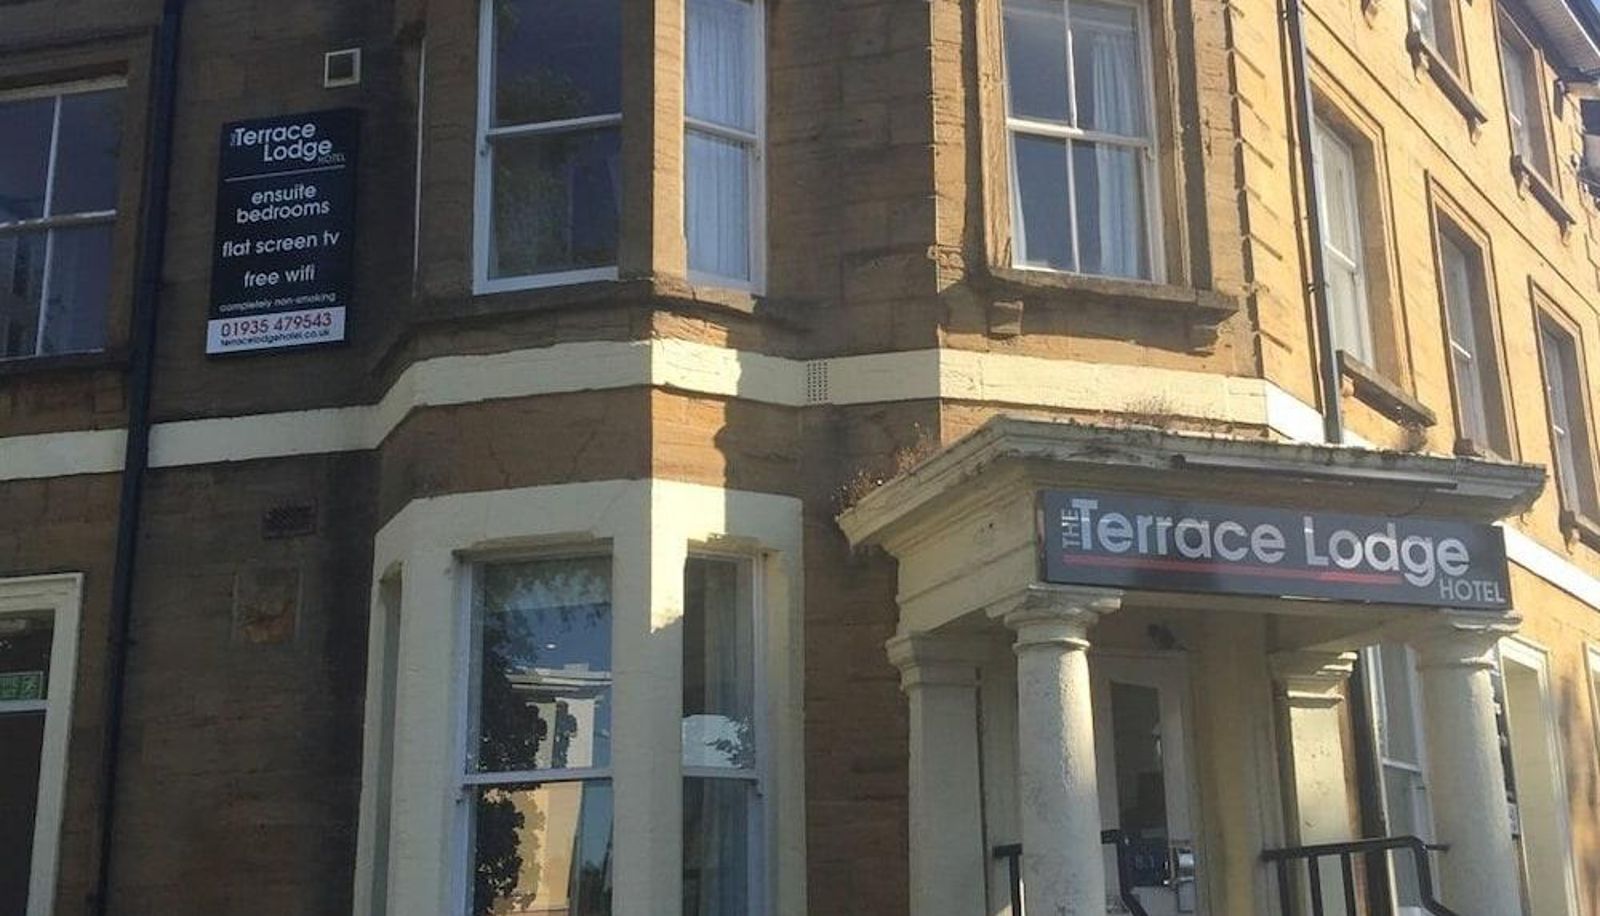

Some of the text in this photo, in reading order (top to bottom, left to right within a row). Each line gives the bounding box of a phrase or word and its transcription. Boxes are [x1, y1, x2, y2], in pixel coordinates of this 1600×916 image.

[235, 123, 316, 146] Terrace
[264, 139, 333, 162] Lodge
[252, 184, 317, 204] ensuite
[236, 200, 331, 224] bedrooms
[222, 230, 340, 258] flat screen tv
[244, 264, 316, 288] free wifi
[221, 312, 333, 337] 01935 479543
[1061, 507, 1081, 549] THE
[1071, 498, 1471, 588] Terrace Lodge
[1439, 579, 1506, 603] HOTEL
